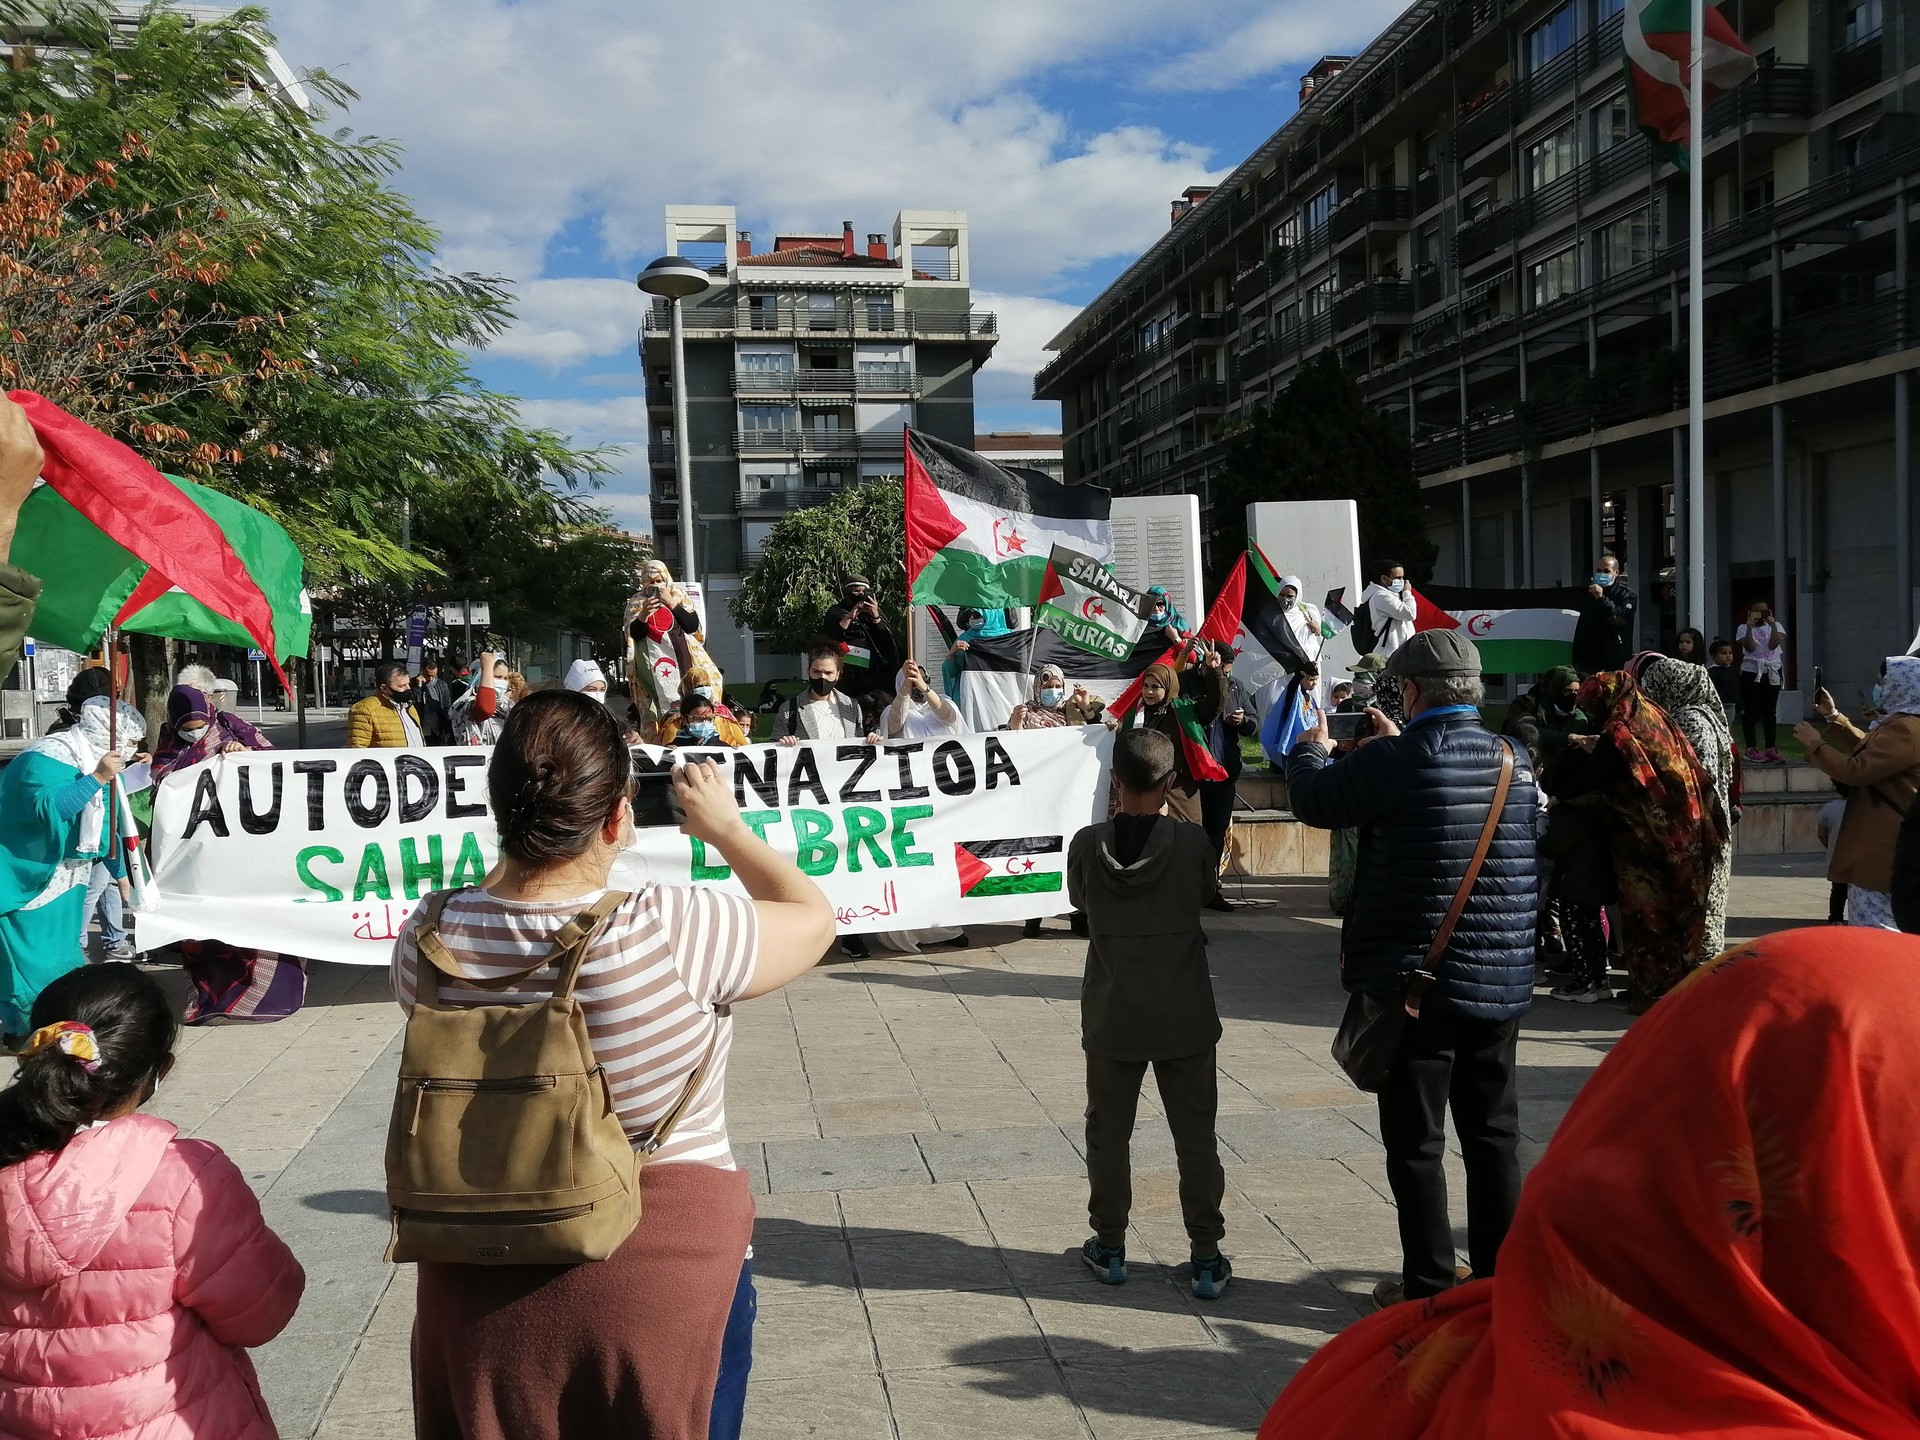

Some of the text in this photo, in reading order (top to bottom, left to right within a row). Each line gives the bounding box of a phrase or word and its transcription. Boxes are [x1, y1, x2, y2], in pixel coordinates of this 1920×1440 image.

[1068, 557, 1142, 614] SAHARA
[1037, 609, 1128, 658] ASTURIAS
[180, 735, 1021, 840] AUTODENAZIOA
[292, 831, 503, 903] SAHA
